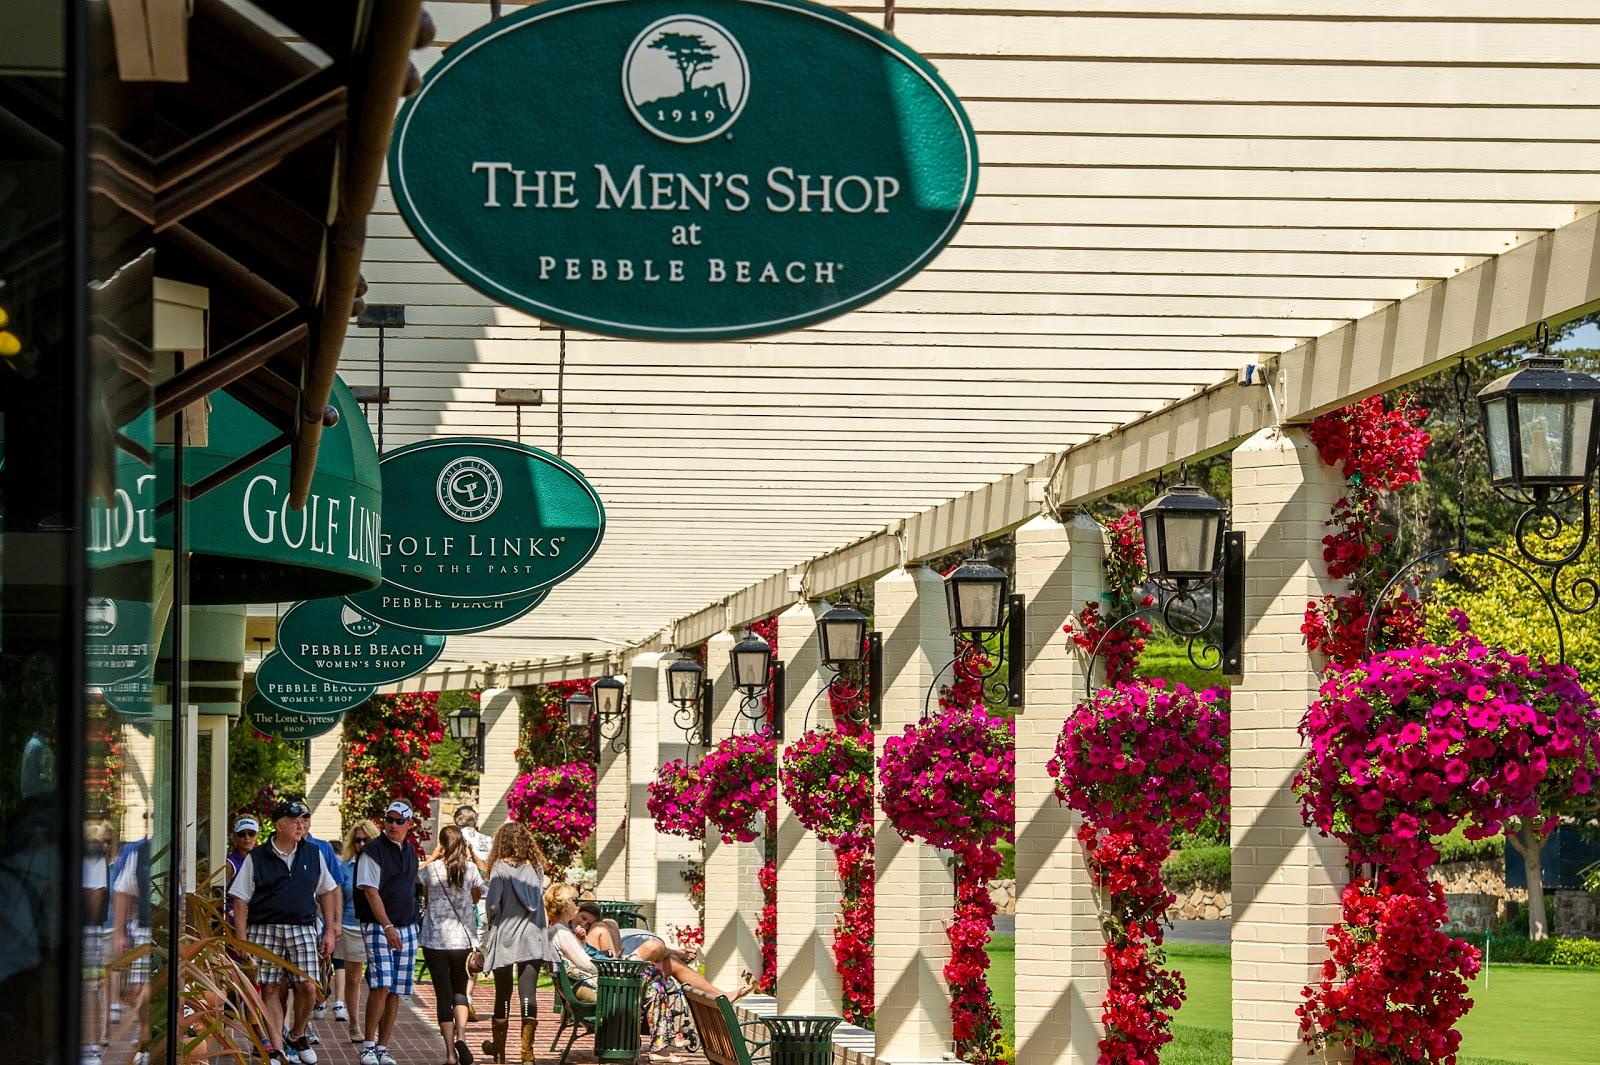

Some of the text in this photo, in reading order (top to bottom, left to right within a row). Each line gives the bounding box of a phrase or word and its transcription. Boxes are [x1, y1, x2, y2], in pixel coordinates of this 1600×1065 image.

[656, 110, 716, 123] 1919
[471, 162, 900, 214] THE MEN'S SHOP
[671, 222, 702, 246] at
[539, 256, 685, 282] PEBBLE
[442, 461, 497, 484] GOLF LINKS
[243, 475, 340, 555] GOLF
[442, 494, 452, 507] TO
[455, 507, 473, 518] THE
[380, 533, 454, 556] GOLF
[400, 564, 532, 574] TO THE PAST
[382, 596, 442, 609] PEBBLE
[301, 643, 424, 656] PEBBLE BEACH
[316, 659, 406, 668] WOMEN'S SHOP
[268, 683, 318, 693] PEBBLE
[255, 713, 334, 725] The Lone Cypress
